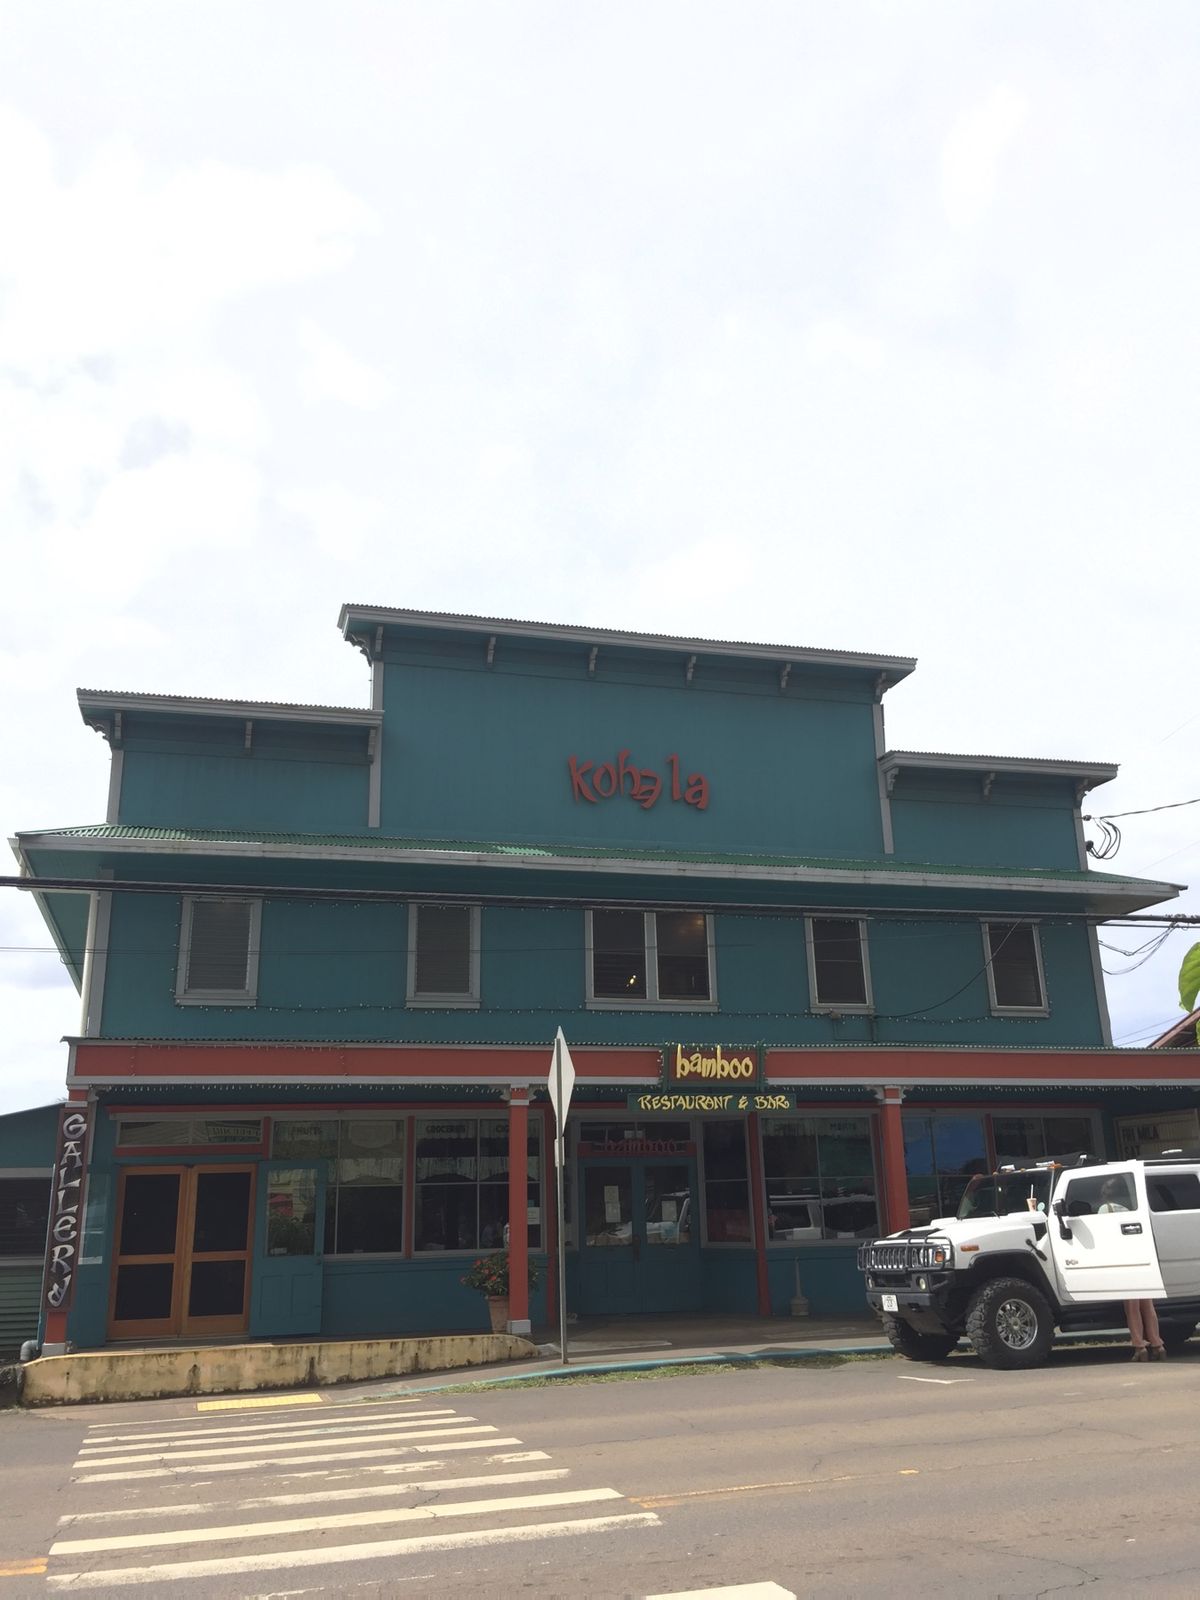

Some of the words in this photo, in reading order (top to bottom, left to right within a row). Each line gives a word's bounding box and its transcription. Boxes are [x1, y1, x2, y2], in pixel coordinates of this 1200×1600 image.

[676, 1043, 753, 1079] bamboo
[637, 1094, 734, 1111] RESTAURANT
[738, 1095, 749, 1110] &
[755, 1094, 790, 1110] BAR
[47, 1113, 88, 1308] GALLERY
